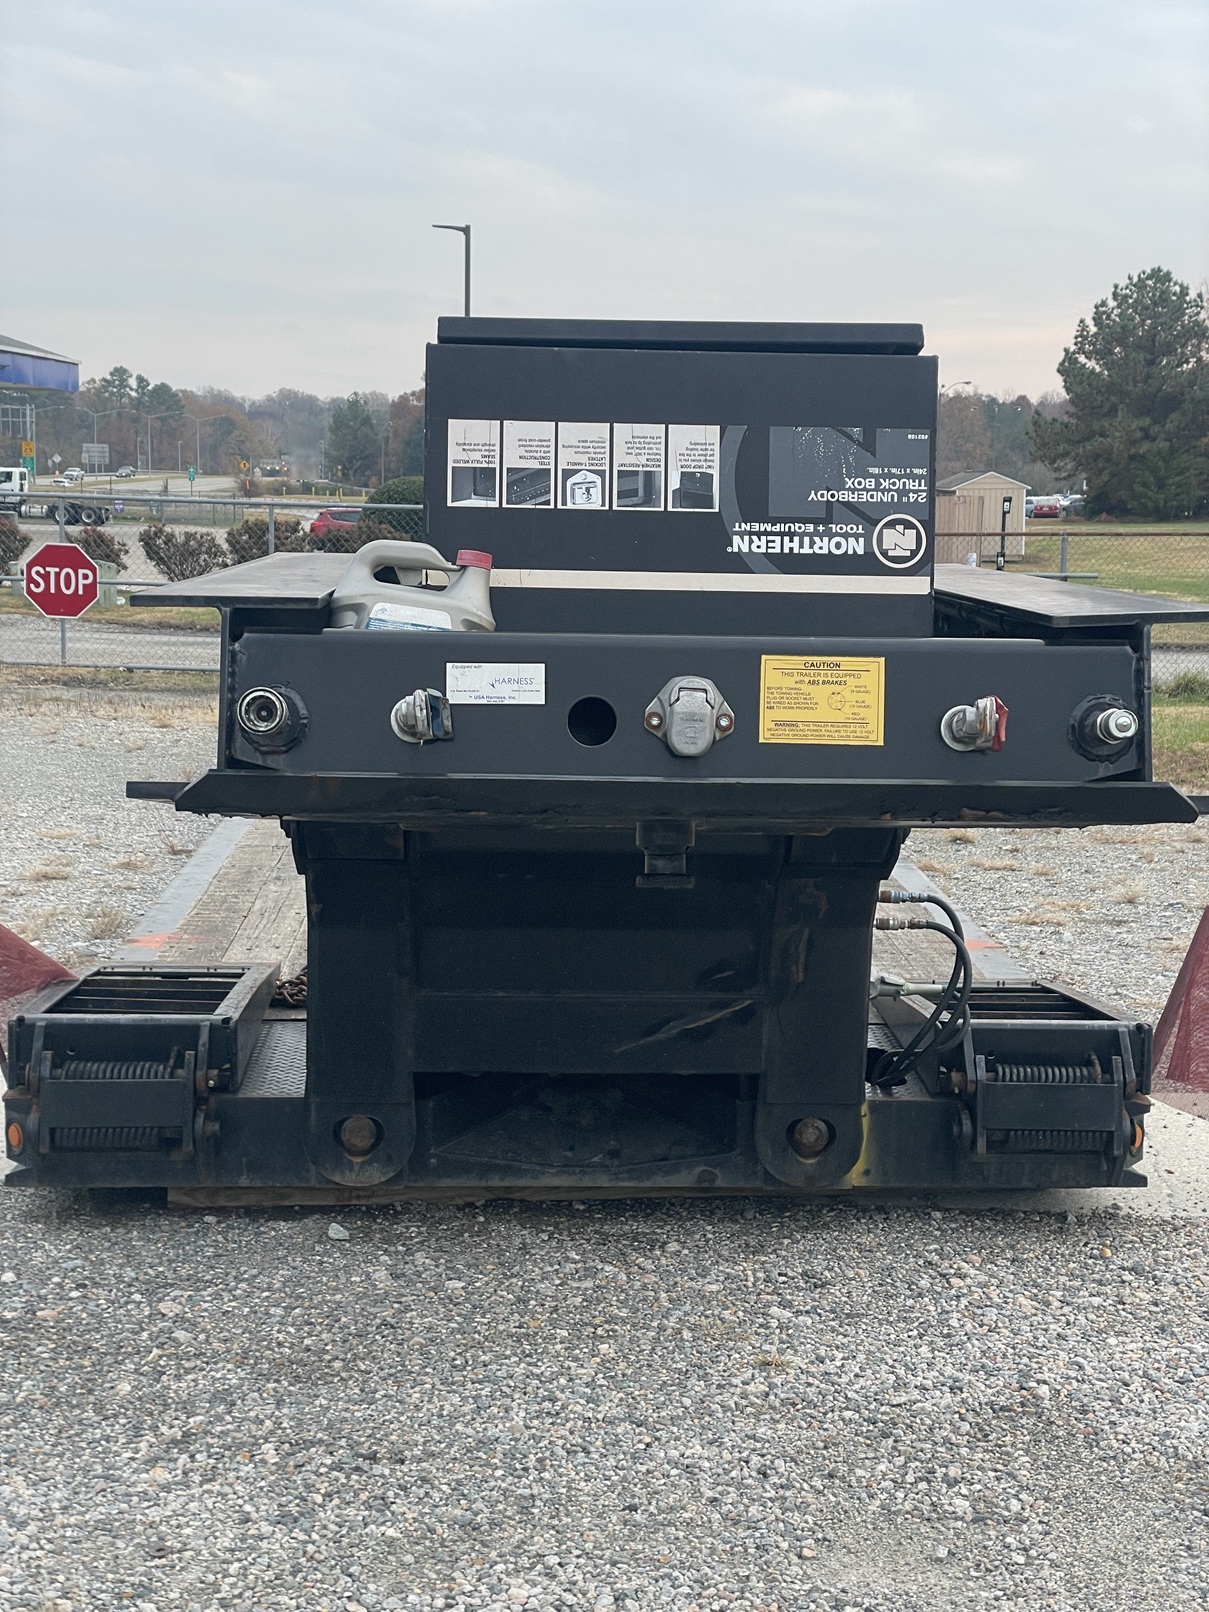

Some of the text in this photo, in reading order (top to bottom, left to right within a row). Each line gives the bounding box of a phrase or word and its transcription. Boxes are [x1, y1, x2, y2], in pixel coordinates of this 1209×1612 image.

[845, 478, 927, 490] TRUCK BOX
[808, 490, 927, 502] 24" UNDERBODY
[732, 522, 814, 532] EQUIPMENT
[829, 524, 864, 533] TOOL
[30, 566, 93, 595] STOP
